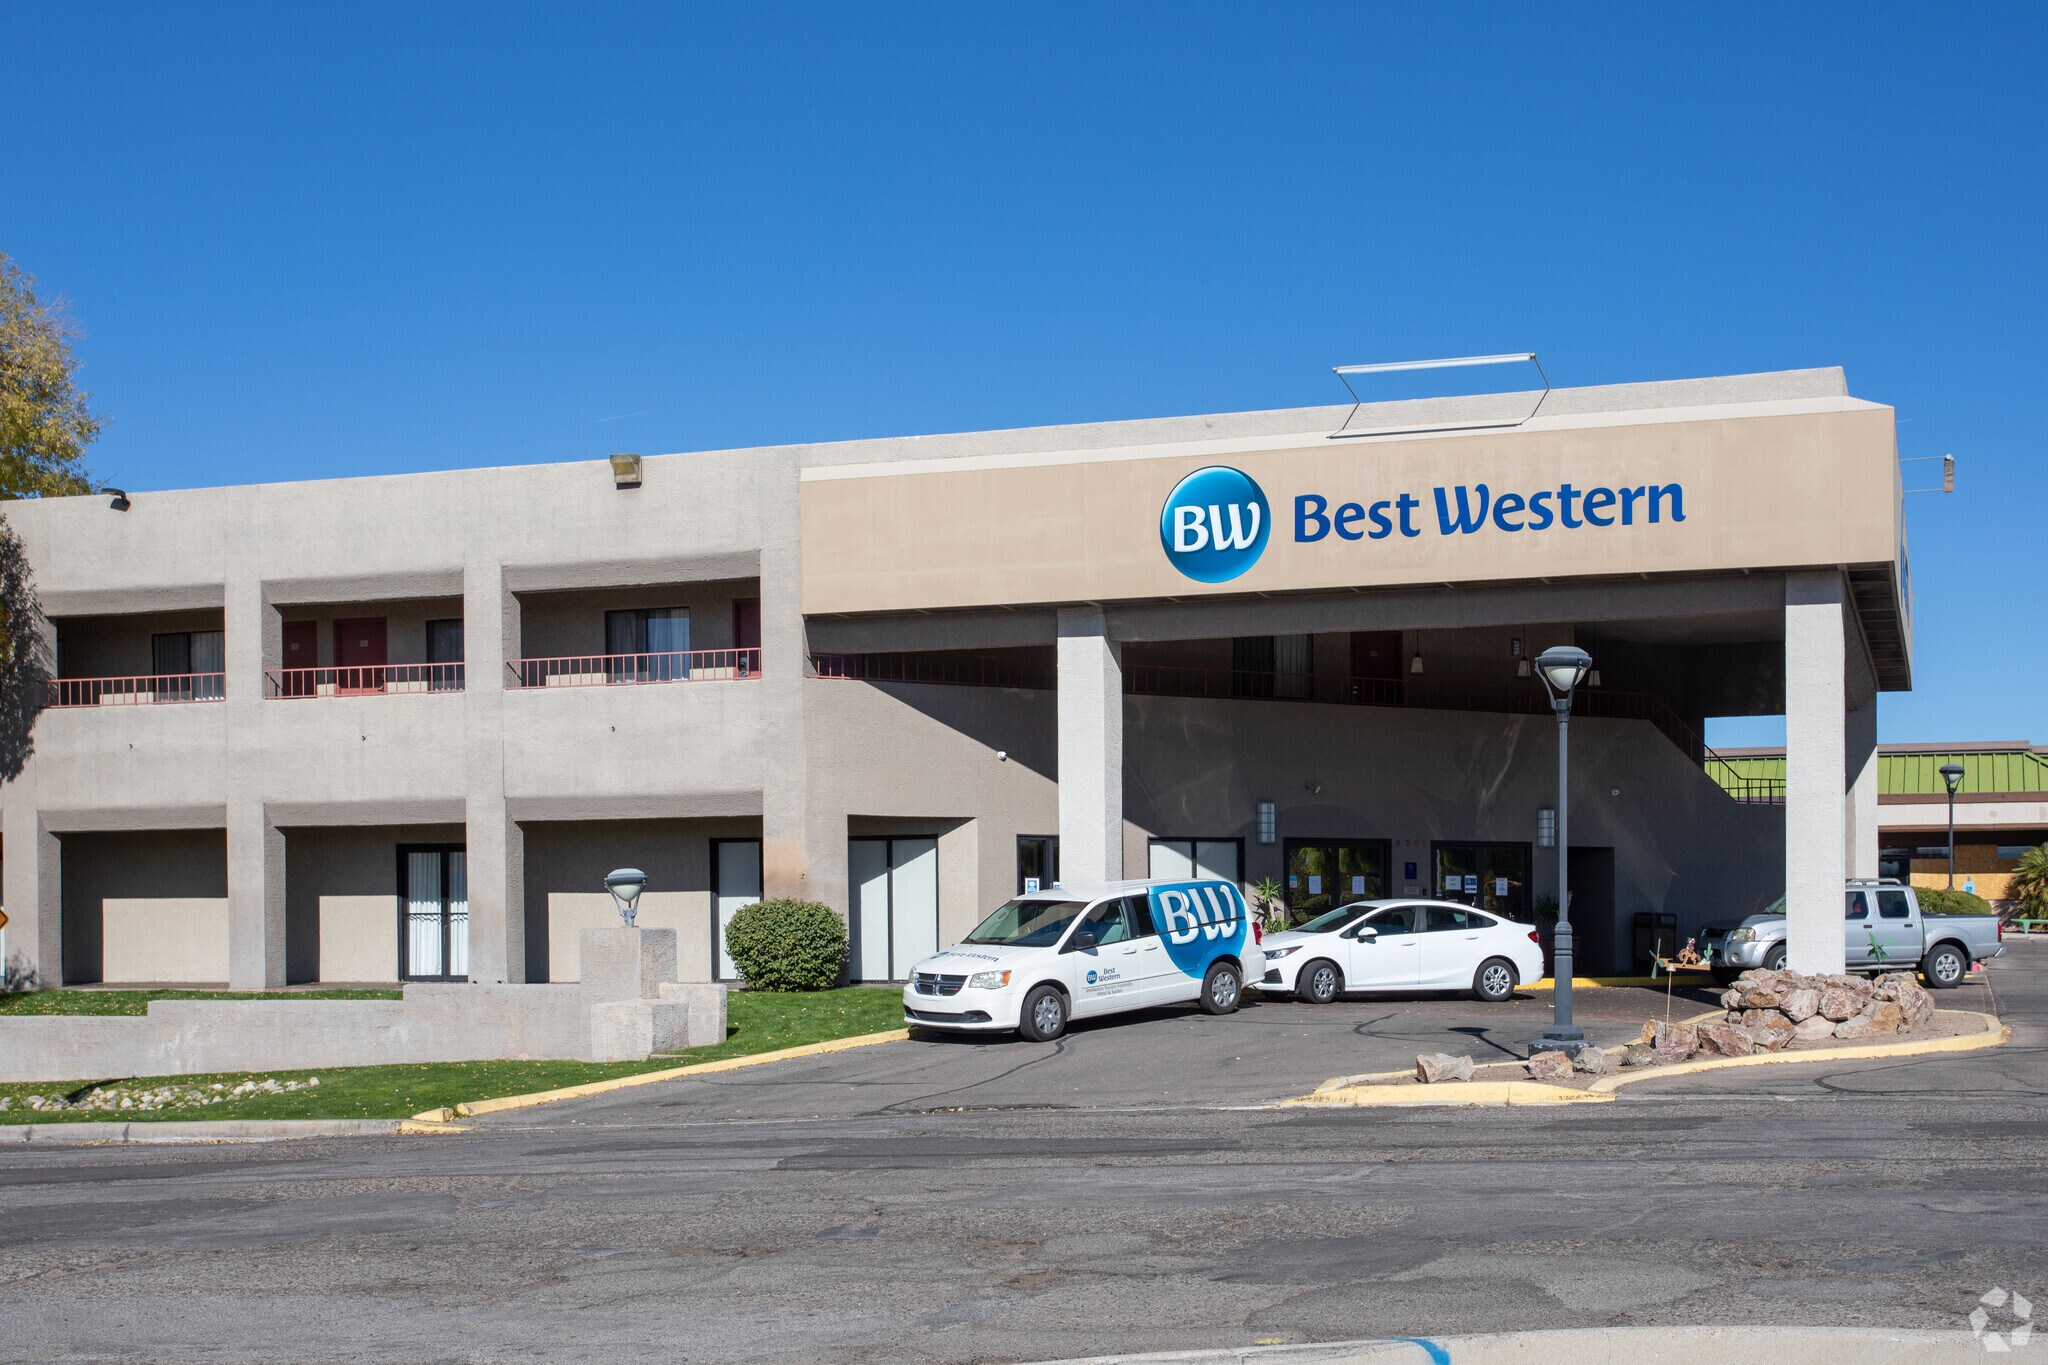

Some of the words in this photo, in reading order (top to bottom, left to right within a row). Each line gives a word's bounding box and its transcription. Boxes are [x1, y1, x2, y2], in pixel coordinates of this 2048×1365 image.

[1174, 501, 1261, 552] BW
[1294, 493, 1421, 543] Best
[1433, 483, 1687, 536] Western
[1158, 884, 1237, 945] BW
[1098, 974, 1120, 982] Western
